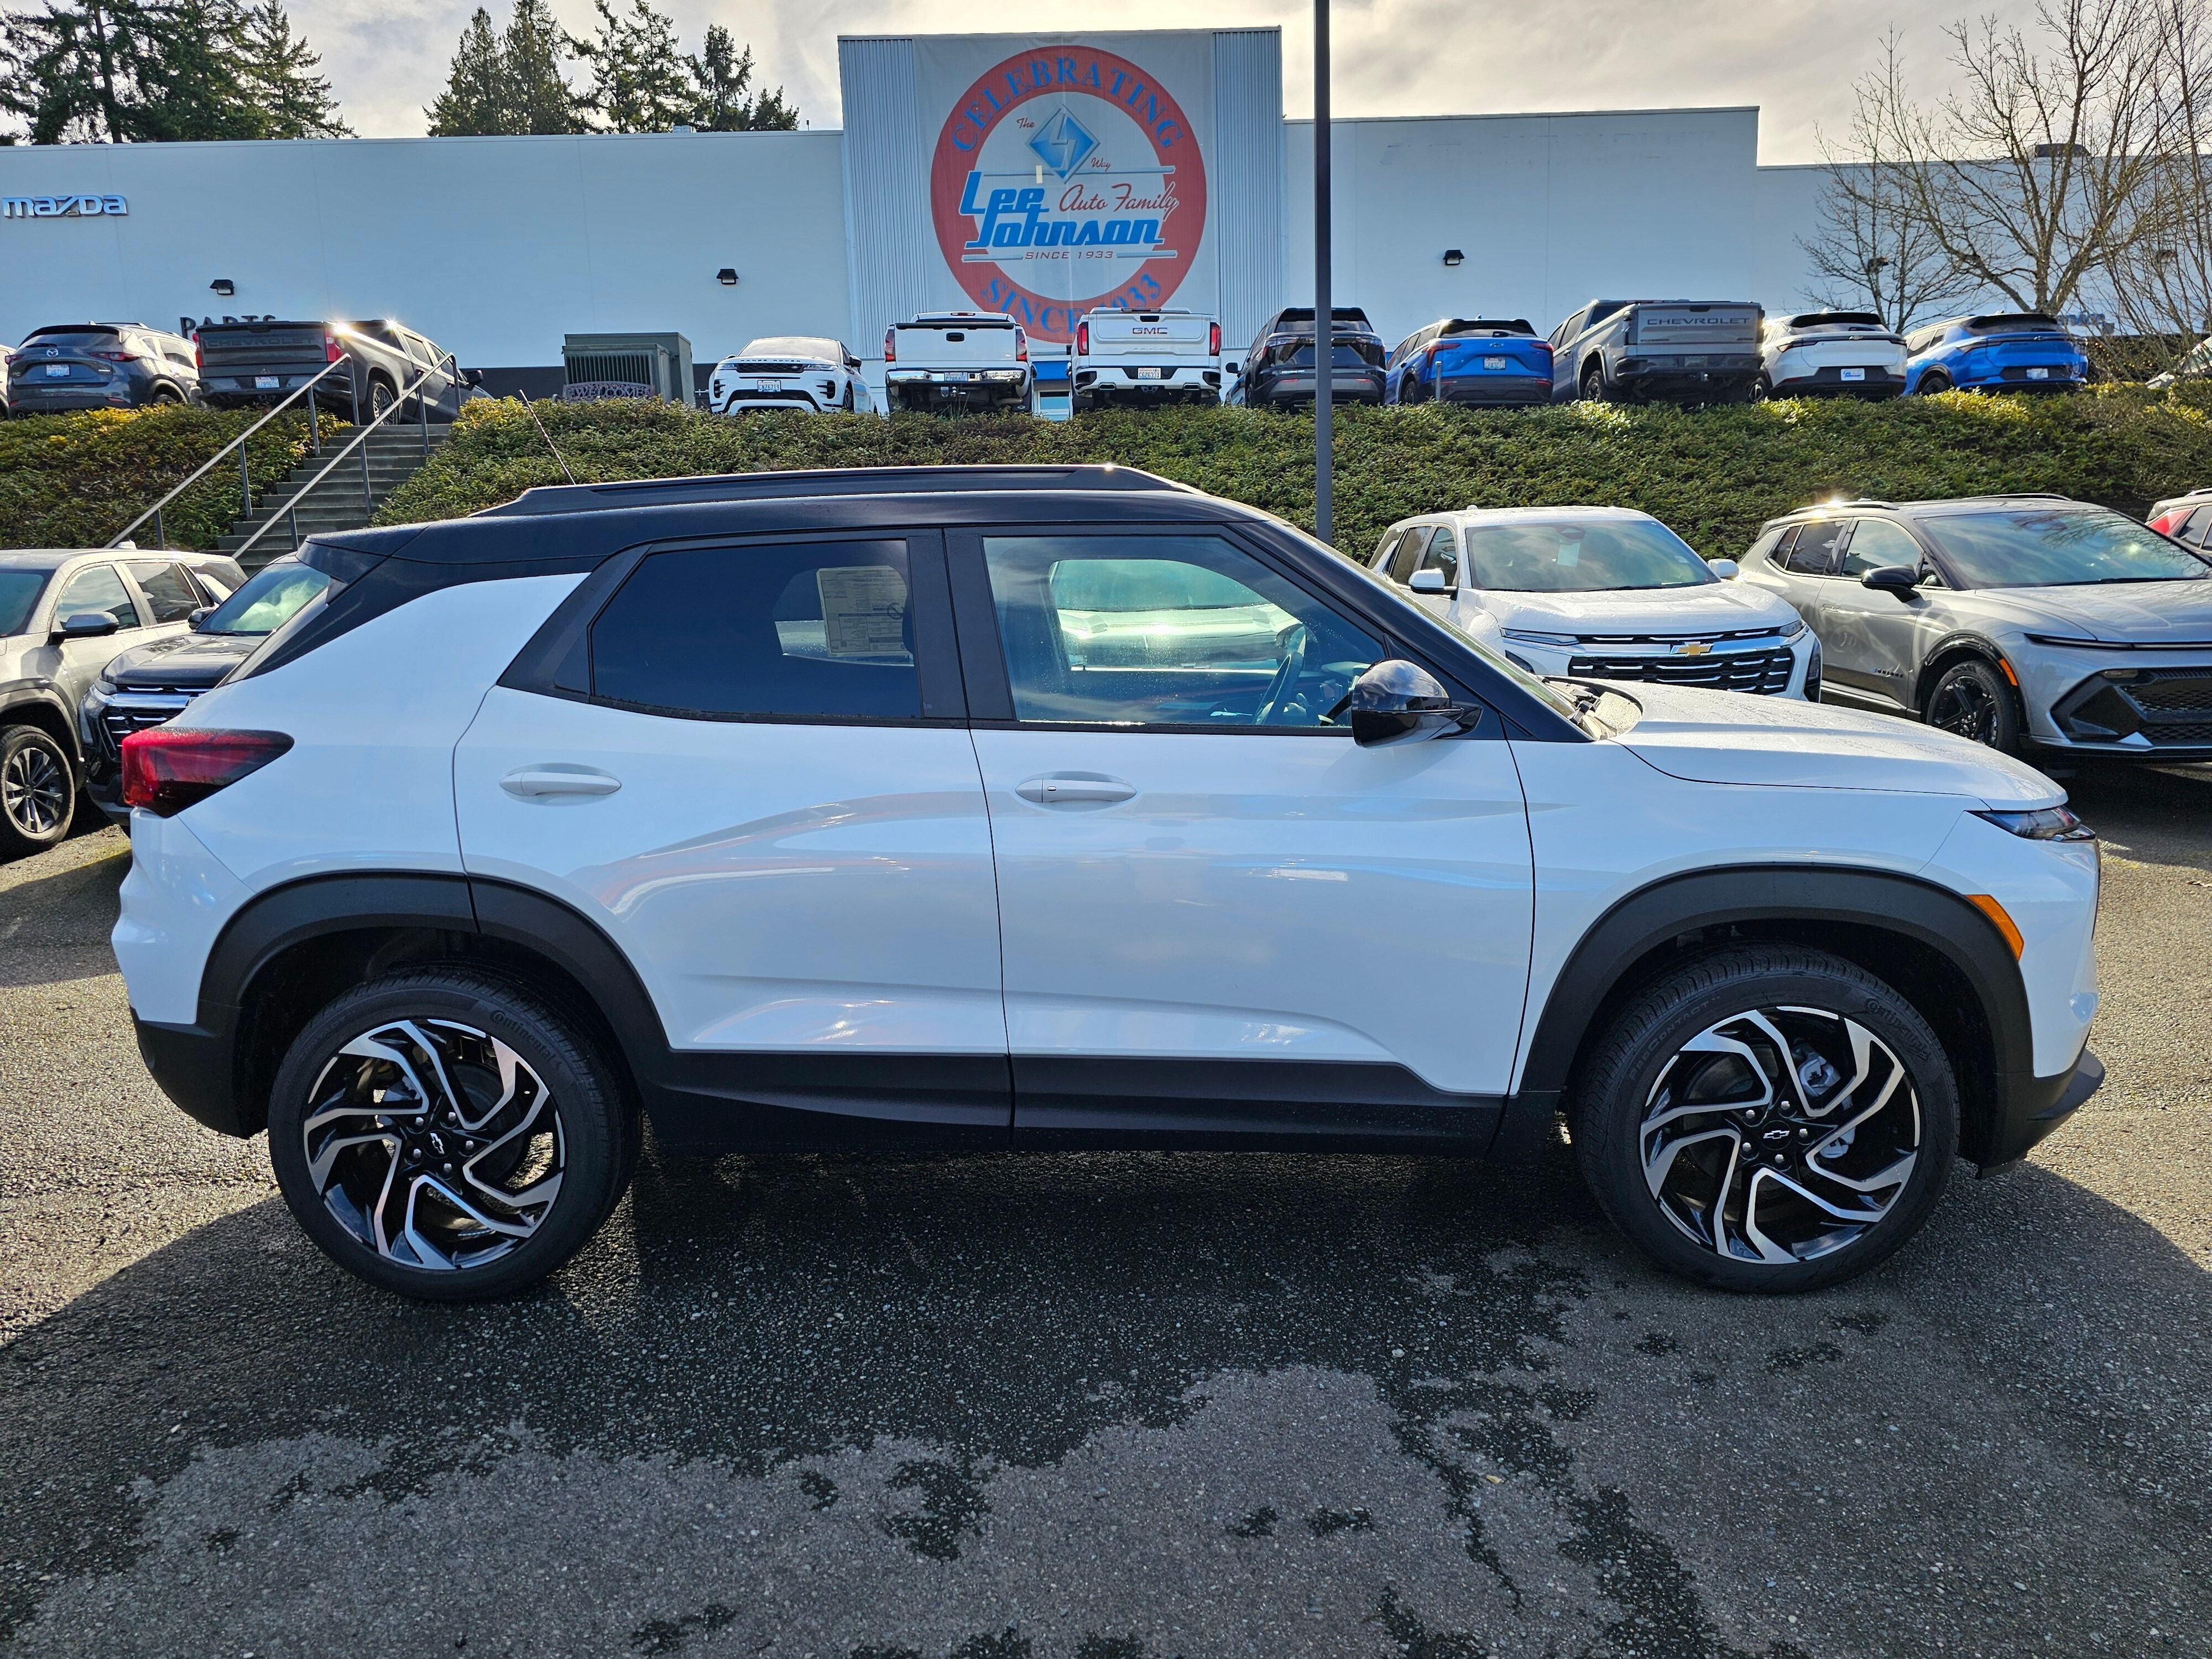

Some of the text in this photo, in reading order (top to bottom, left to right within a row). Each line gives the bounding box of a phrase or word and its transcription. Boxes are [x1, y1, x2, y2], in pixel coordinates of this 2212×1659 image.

[953, 57, 1182, 152] CELEBRATING
[1016, 117, 1036, 129] The
[1091, 157, 1111, 172] Way
[2, 195, 128, 218] mazda
[959, 171, 1050, 215] Lee
[1059, 181, 1179, 222] Auto Family
[964, 205, 1165, 249] Johnson
[981, 278, 1084, 334] SINCE
[207, 337, 312, 347] CHEVROLET
[574, 387, 645, 399] WELCOME
[490, 1010, 556, 1061] Continental
